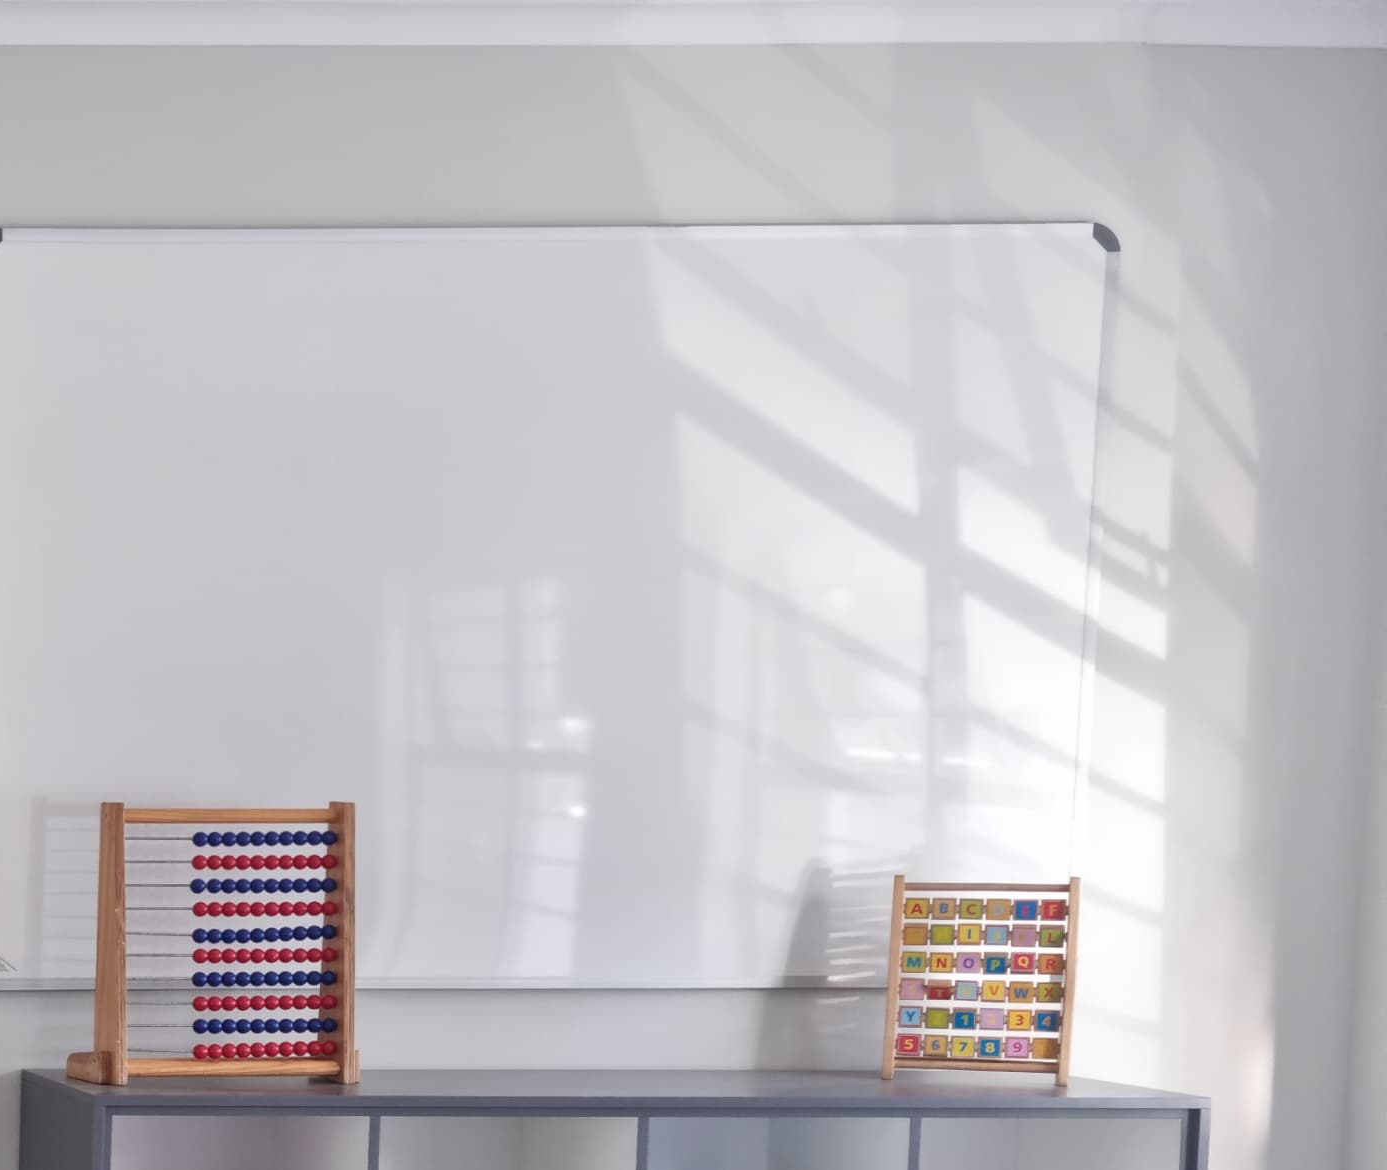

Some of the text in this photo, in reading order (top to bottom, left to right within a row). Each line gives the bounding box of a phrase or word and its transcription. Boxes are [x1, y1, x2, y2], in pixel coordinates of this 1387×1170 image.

[910, 904, 923, 915] A
[939, 903, 948, 914] B
[967, 904, 976, 915] C
[1049, 904, 1058, 915] F
[907, 957, 922, 968] M
[936, 958, 947, 969] N
[963, 958, 974, 969] O
[991, 960, 1001, 971] P
[1018, 956, 1029, 967] Q
[989, 986, 999, 996] V
[1014, 988, 1028, 998] W
[906, 1011, 915, 1022] Y
[1015, 1015, 1024, 1025] 3
[904, 1039, 1022, 1053] 5 6 7 8 9
